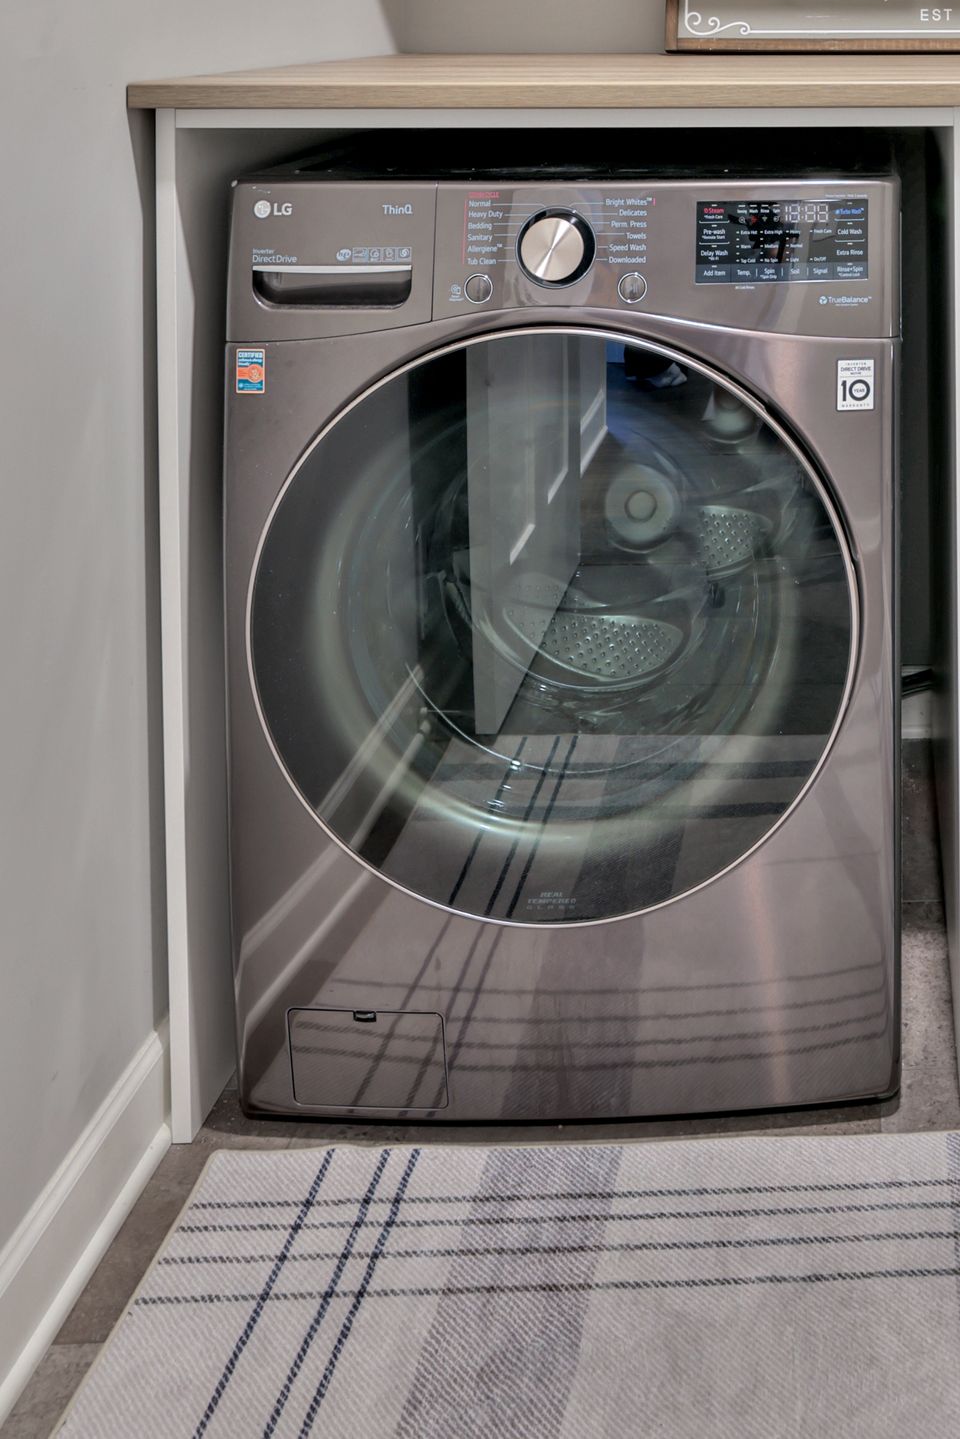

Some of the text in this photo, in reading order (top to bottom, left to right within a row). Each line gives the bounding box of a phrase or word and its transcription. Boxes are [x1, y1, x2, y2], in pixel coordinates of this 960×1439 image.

[920, 9, 954, 22] EST
[606, 198, 625, 207] Bright
[273, 203, 292, 216] LG
[383, 204, 413, 215] ThinQ
[488, 211, 503, 219] Duty
[468, 222, 492, 230] Bedding
[630, 220, 647, 228] Press
[468, 234, 492, 242] Sanitary
[609, 243, 646, 252] Speed Wash
[841, 379, 870, 401] 10
